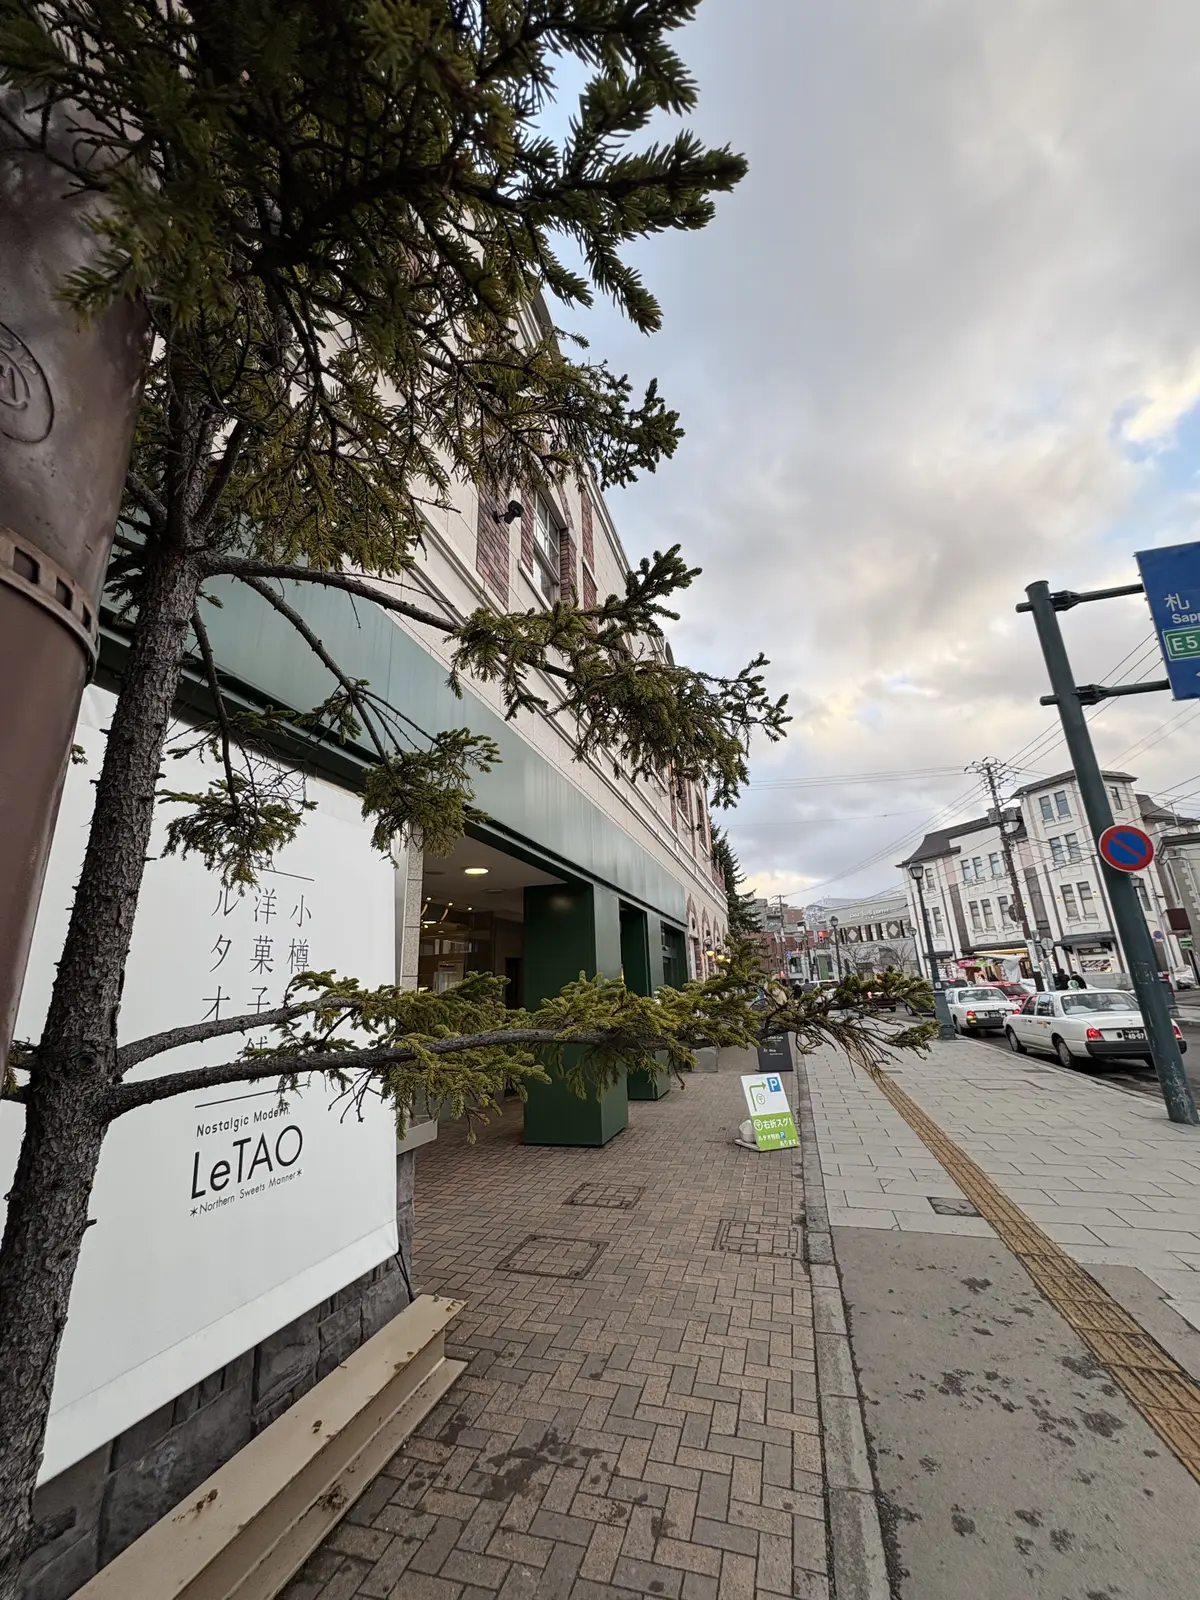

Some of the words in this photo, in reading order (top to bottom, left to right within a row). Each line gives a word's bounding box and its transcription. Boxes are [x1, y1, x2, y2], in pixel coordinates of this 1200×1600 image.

[1171, 635, 1198, 651] E5
[286, 894, 312, 975] 小樽
[201, 885, 240, 1021] ルタオ
[769, 1078, 778, 1091] P
[196, 1115, 249, 1138] Nostalgic
[191, 1124, 303, 1200] LeTAO
[239, 1183, 266, 1199] Sweets
